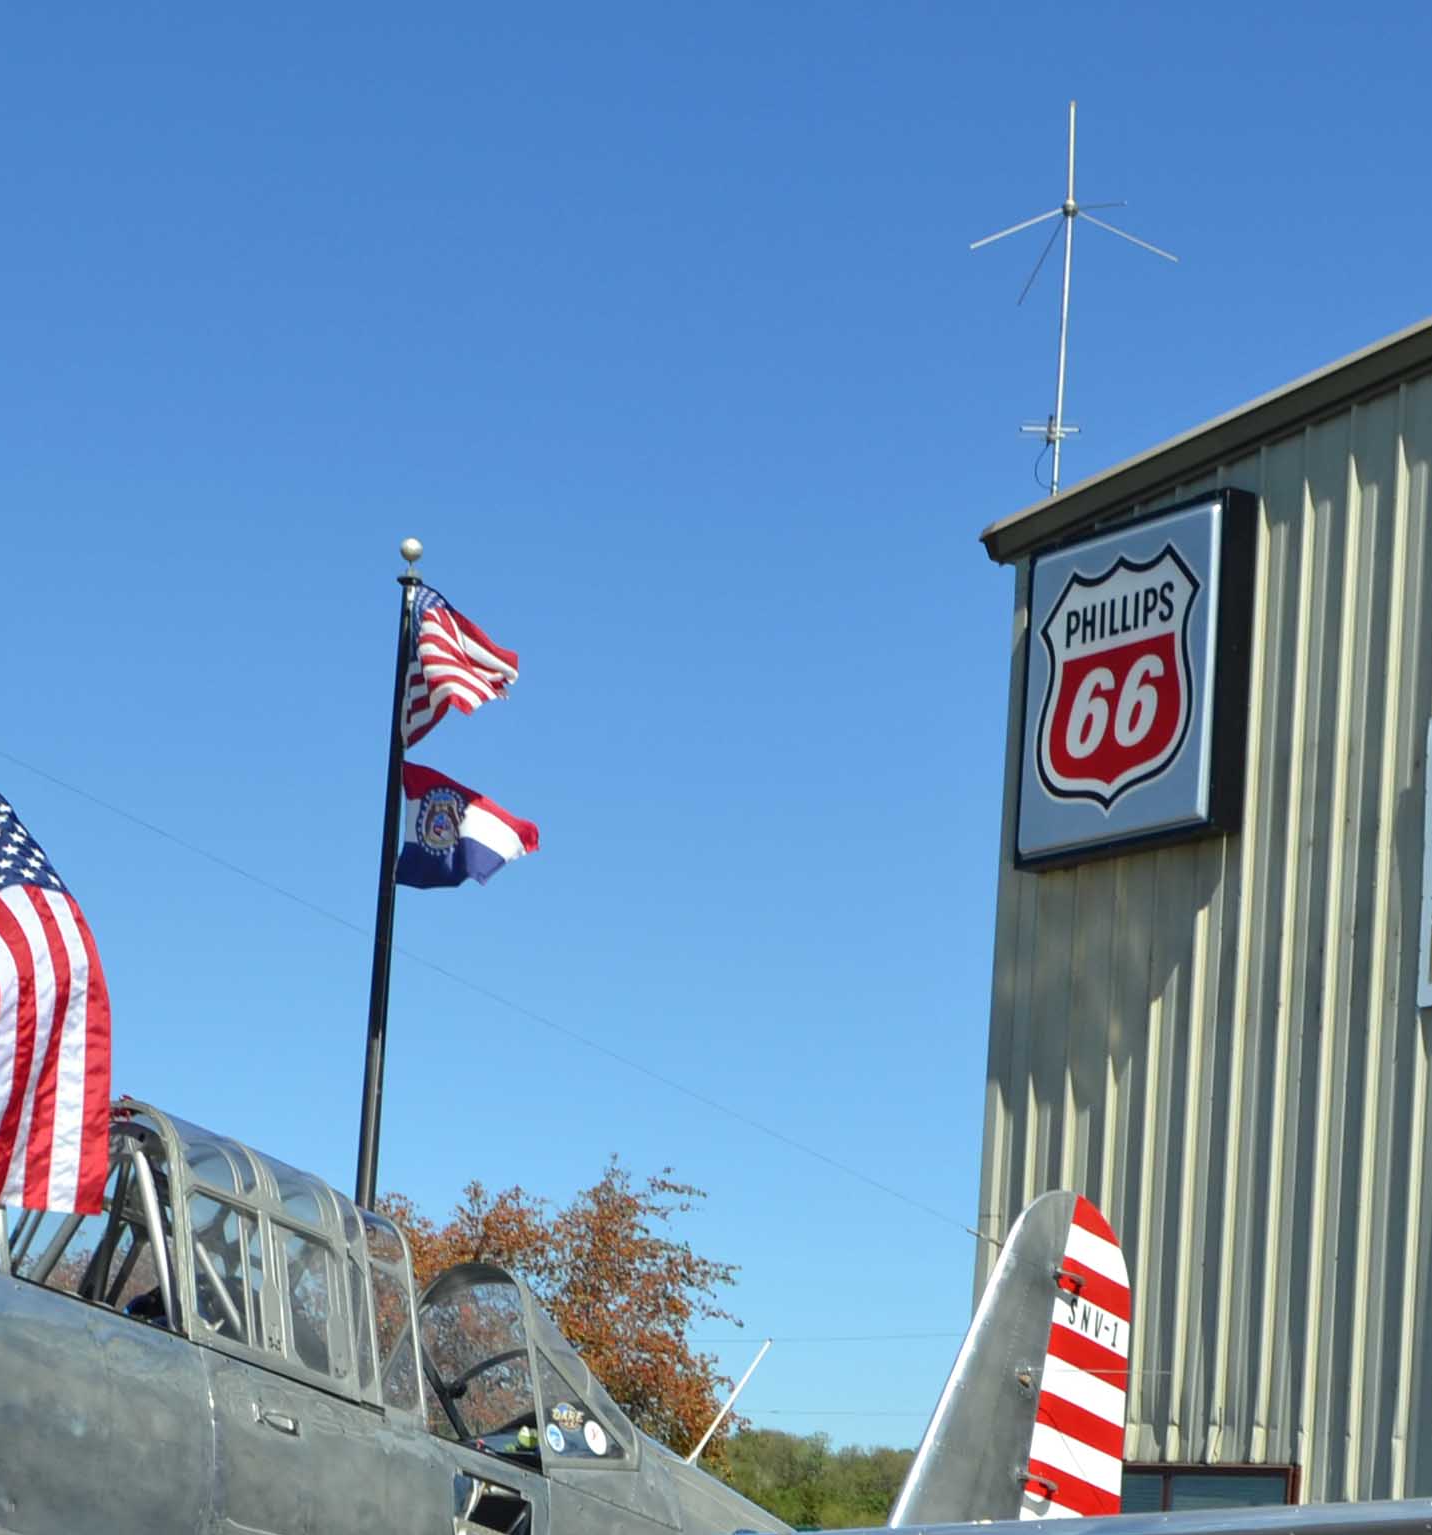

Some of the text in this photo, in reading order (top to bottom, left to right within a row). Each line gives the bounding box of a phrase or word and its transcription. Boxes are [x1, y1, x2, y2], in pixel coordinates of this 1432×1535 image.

[1066, 581, 1175, 649] PHILLIPS
[1065, 653, 1165, 759] 66
[1068, 1297, 1118, 1348] SNV-1
